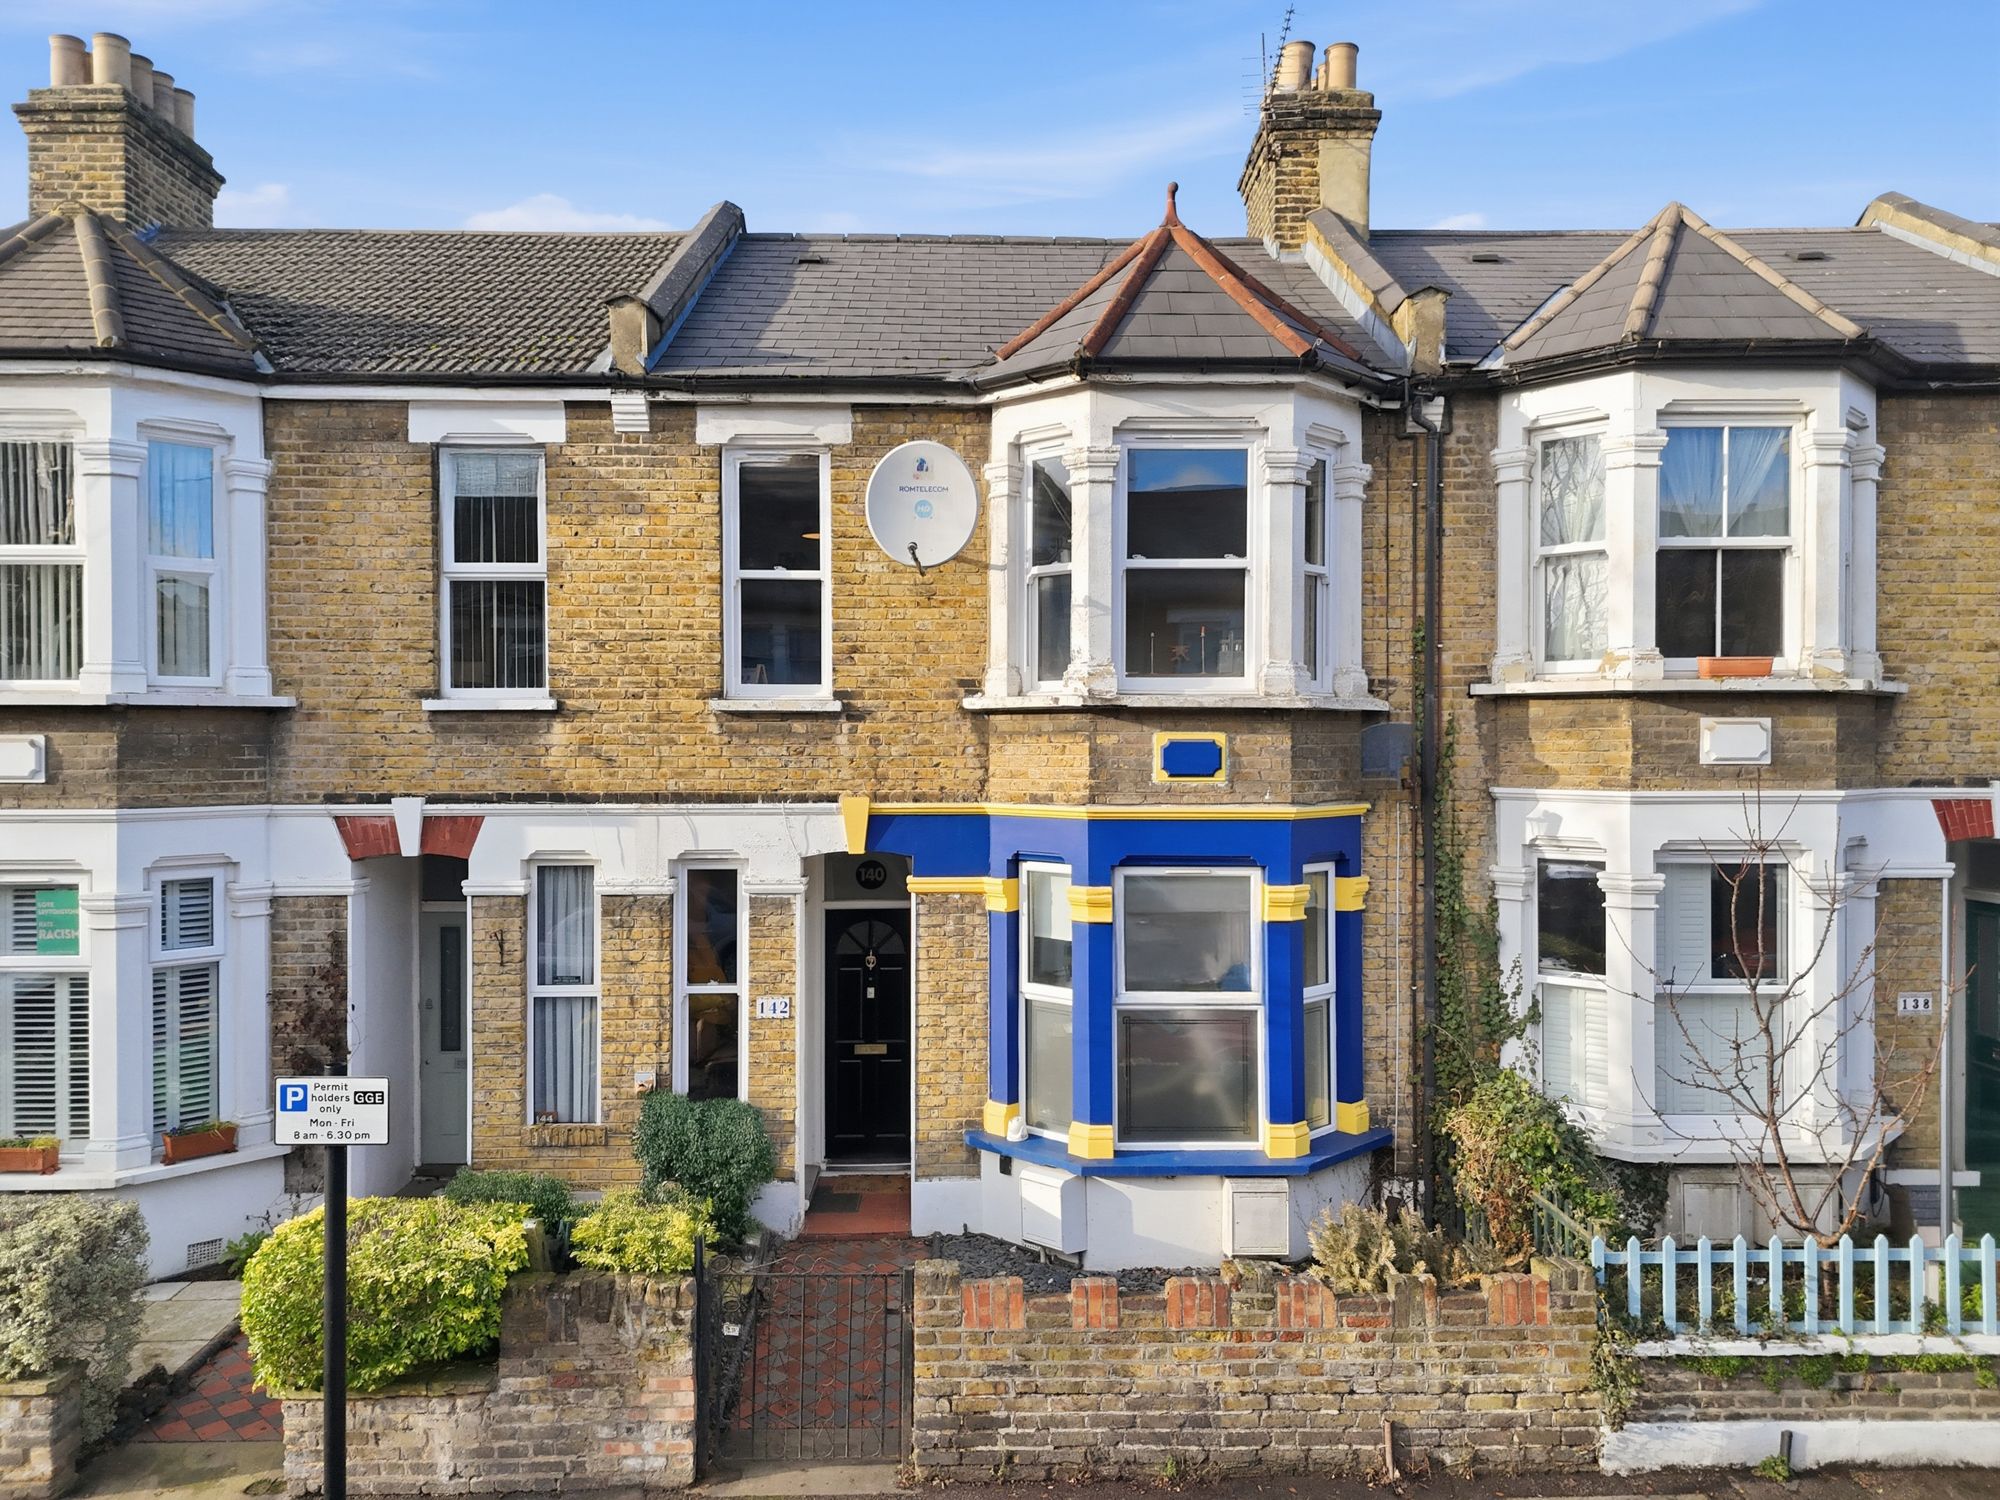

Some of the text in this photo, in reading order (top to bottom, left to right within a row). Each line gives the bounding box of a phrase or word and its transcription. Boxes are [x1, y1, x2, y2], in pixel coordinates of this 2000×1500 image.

[899, 485, 949, 493] ROMTELECOM
[859, 867, 885, 881] 140
[760, 1001, 788, 1014] 142
[1902, 998, 1930, 1010] 138
[313, 1082, 348, 1091] Permit
[286, 1087, 305, 1110] P
[311, 1094, 350, 1102] holders
[355, 1092, 383, 1104] GGE
[319, 1104, 342, 1114] only
[309, 1118, 332, 1127] Mon
[341, 1118, 355, 1127] Fri
[293, 1130, 301, 1139] 8
[302, 1132, 318, 1140] am
[326, 1130, 352, 1140] 6.30
[354, 1132, 371, 1141] pm
